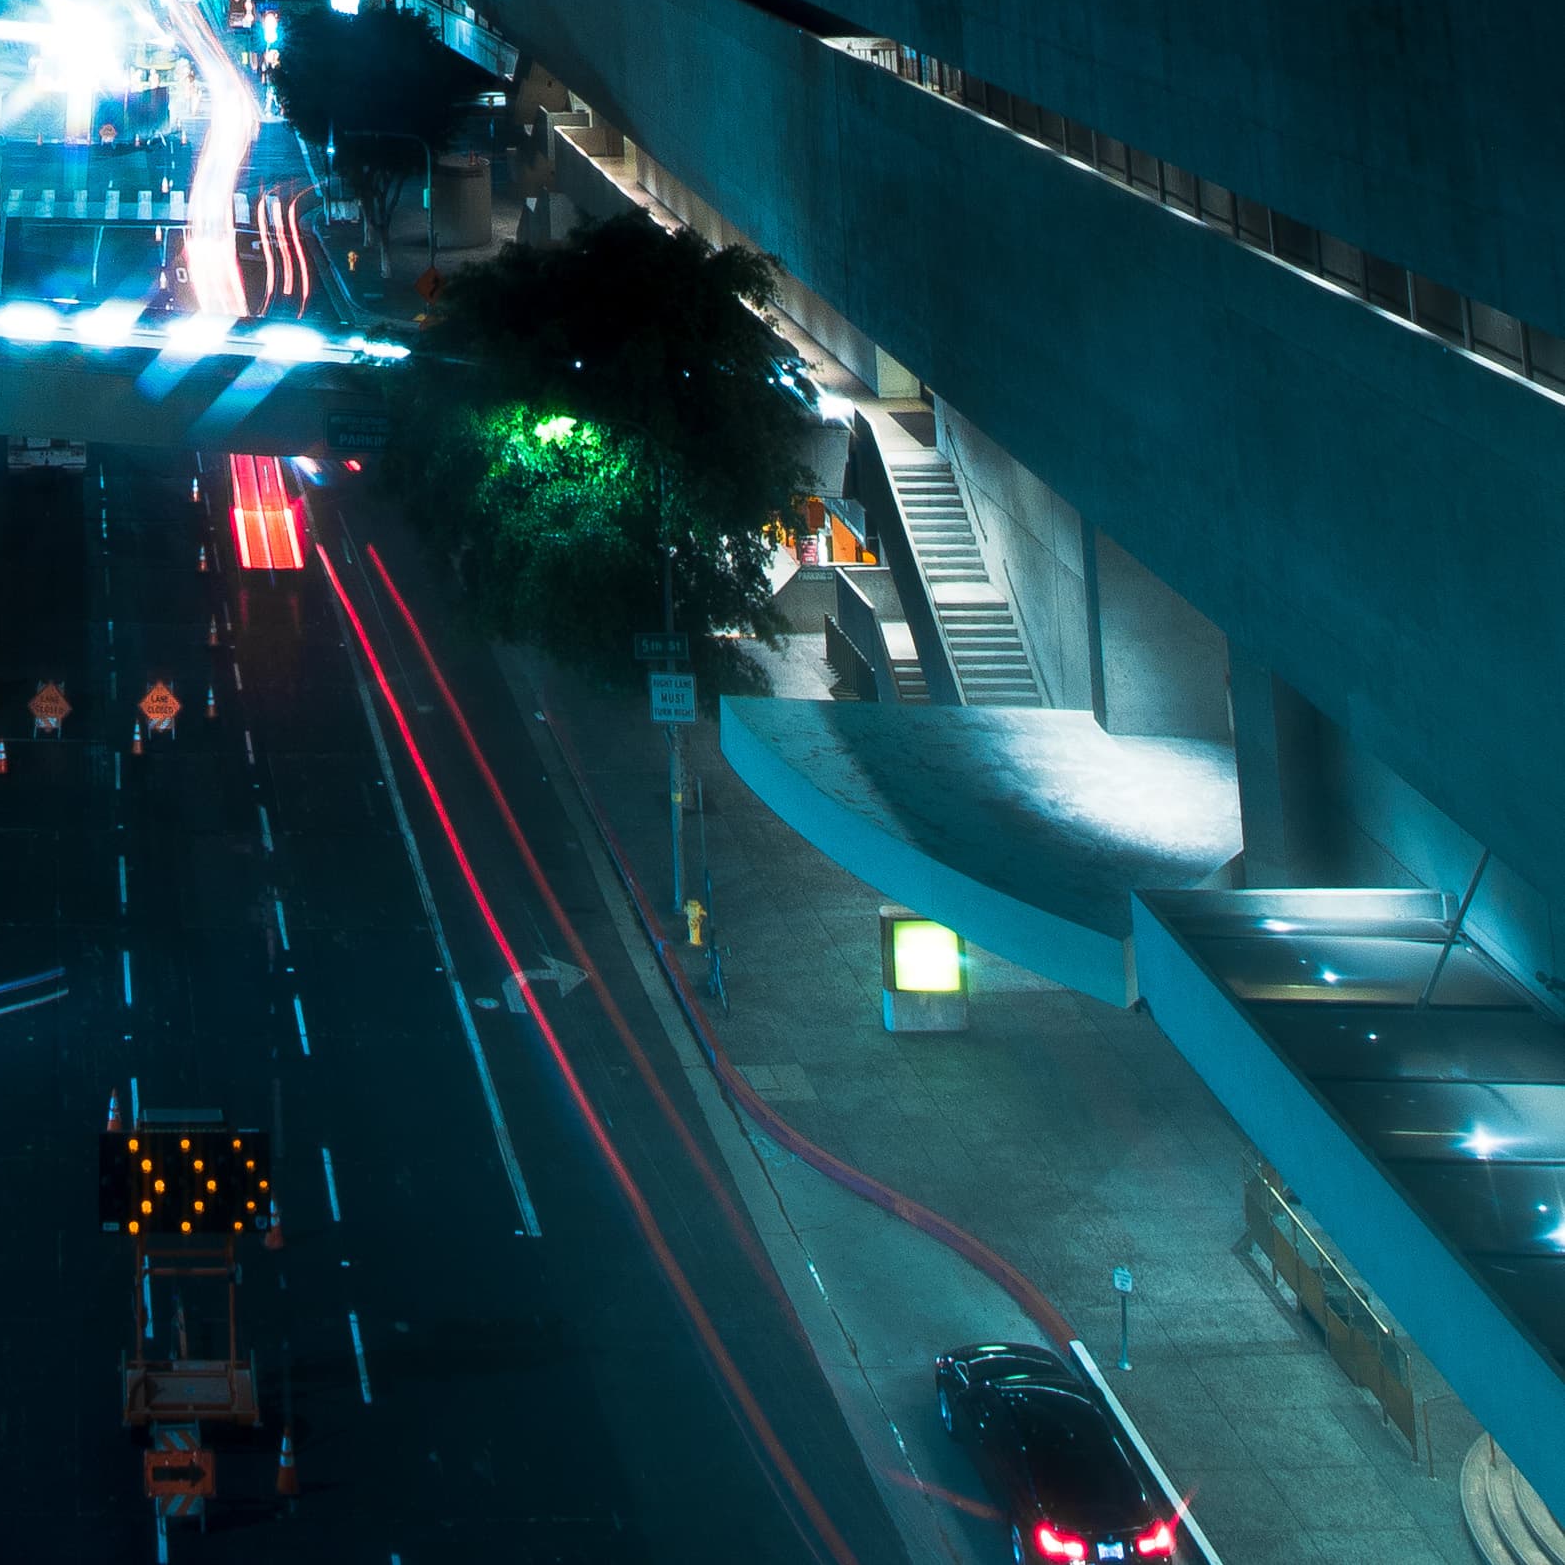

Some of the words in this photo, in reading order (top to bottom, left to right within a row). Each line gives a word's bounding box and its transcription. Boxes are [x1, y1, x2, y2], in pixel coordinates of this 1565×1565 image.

[339, 433, 388, 447] PARKIN
[661, 693, 684, 703] MUST
[147, 706, 173, 714] CLOSED
